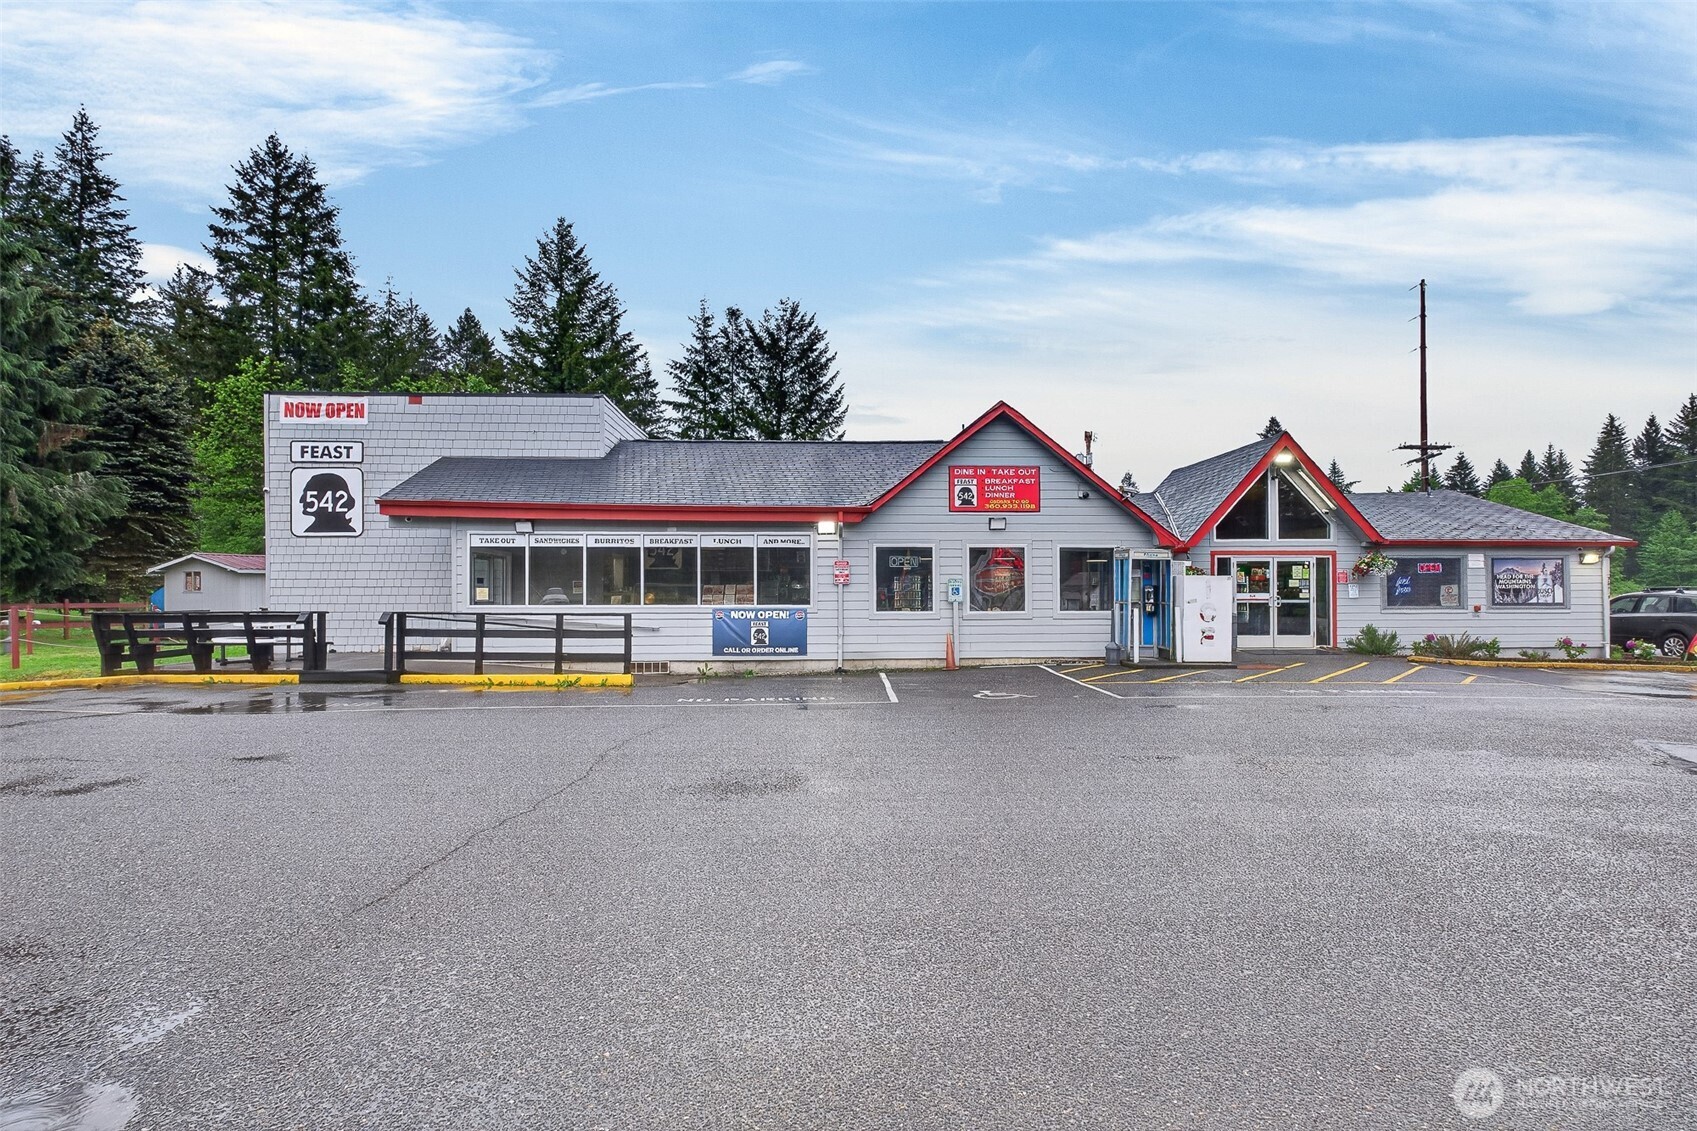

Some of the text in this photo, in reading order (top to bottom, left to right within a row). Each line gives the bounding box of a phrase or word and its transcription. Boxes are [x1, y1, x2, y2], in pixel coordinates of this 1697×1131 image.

[284, 402, 365, 419] NOW OPEN
[300, 445, 353, 459] FEAST
[991, 468, 1015, 476] TAKE
[305, 490, 348, 512] 542
[958, 492, 973, 500] 542
[891, 556, 917, 566] OPEN
[730, 610, 790, 619] NOW OPEN!
